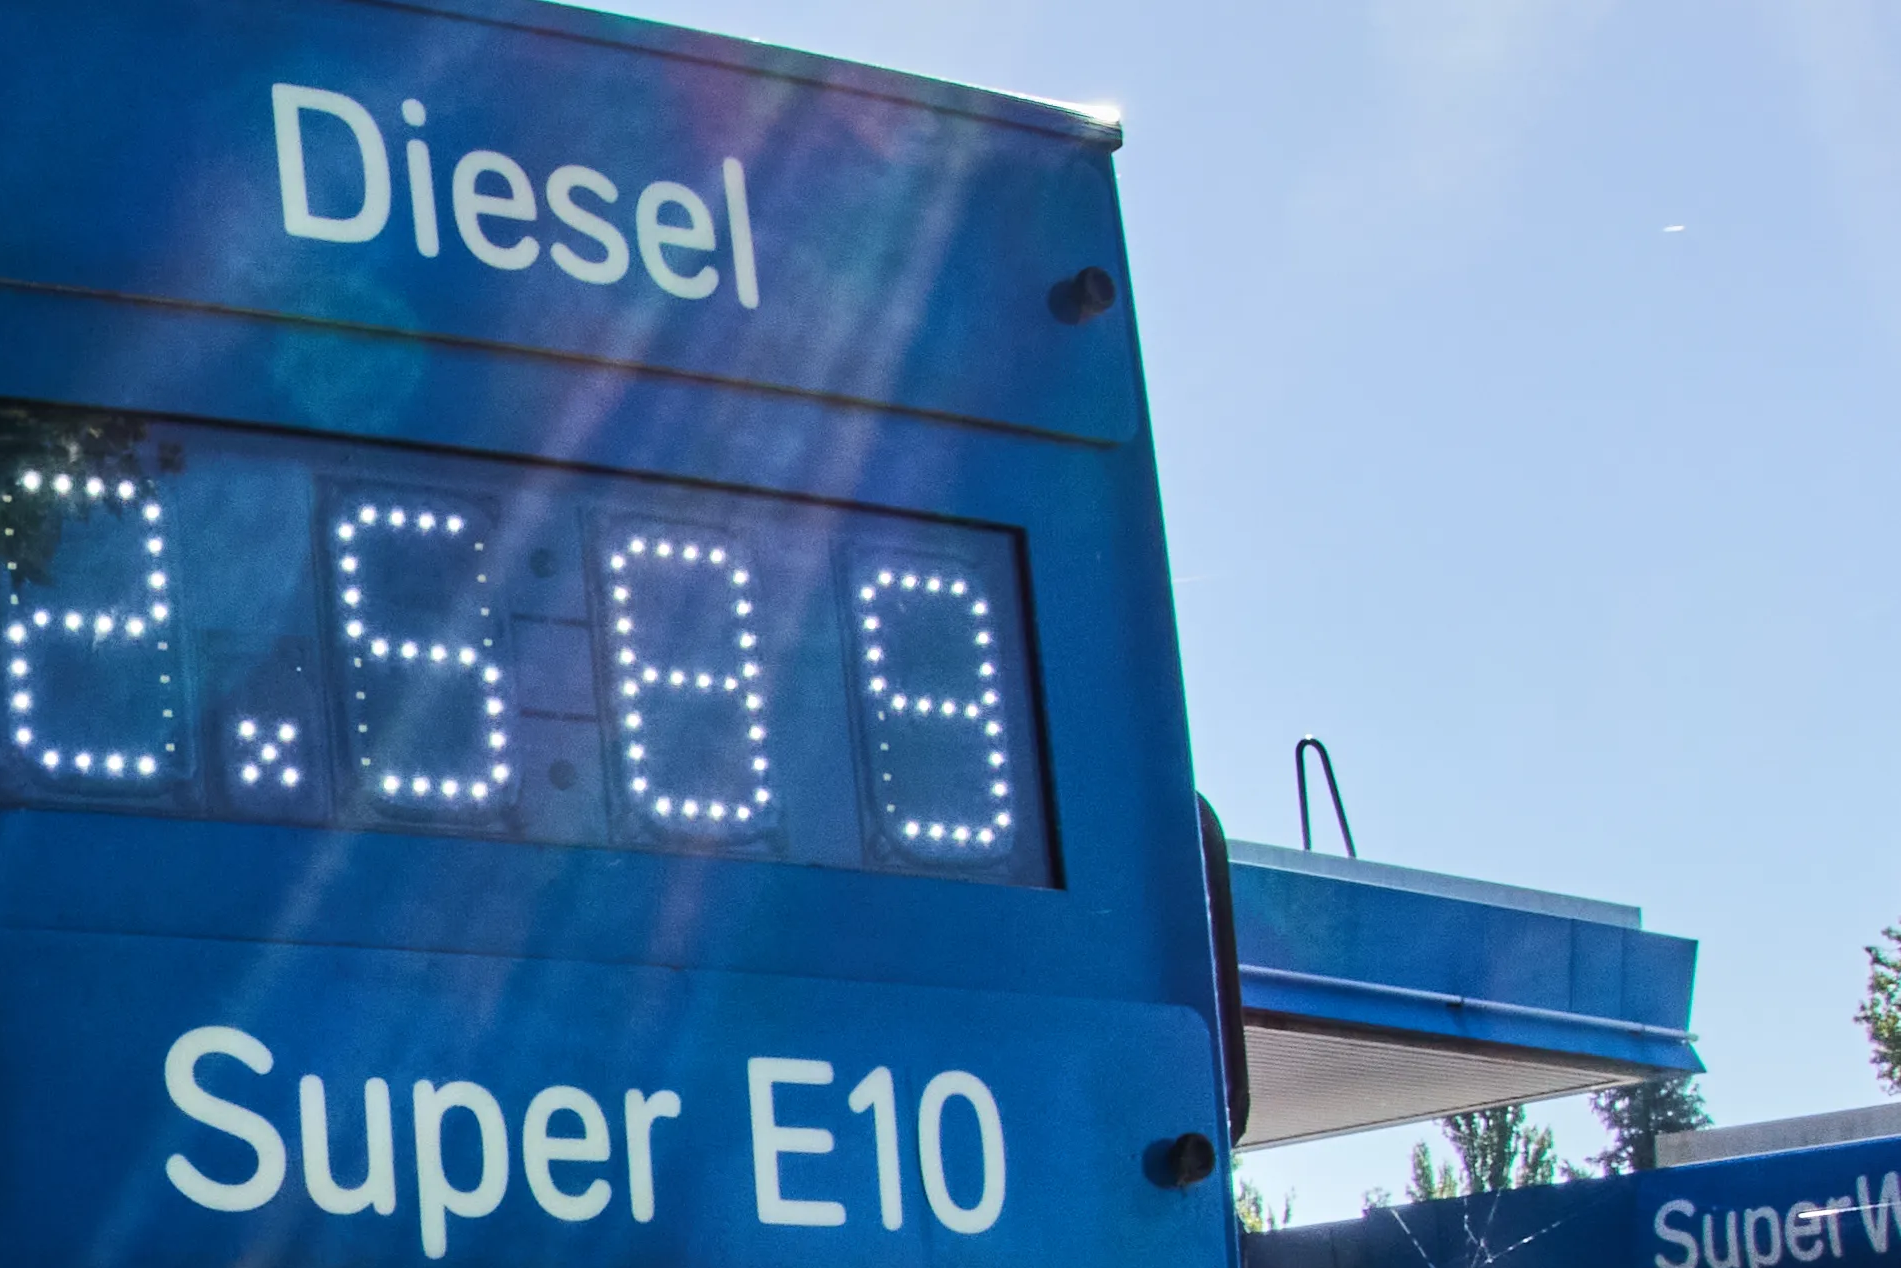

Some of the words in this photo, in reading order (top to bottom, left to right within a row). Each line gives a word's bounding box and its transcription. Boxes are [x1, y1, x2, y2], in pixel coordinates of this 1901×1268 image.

[271, 82, 760, 310] Diesel
[6, 470, 1012, 845] 2.589
[164, 1024, 683, 1260] Super
[747, 1056, 1007, 1235] E10
